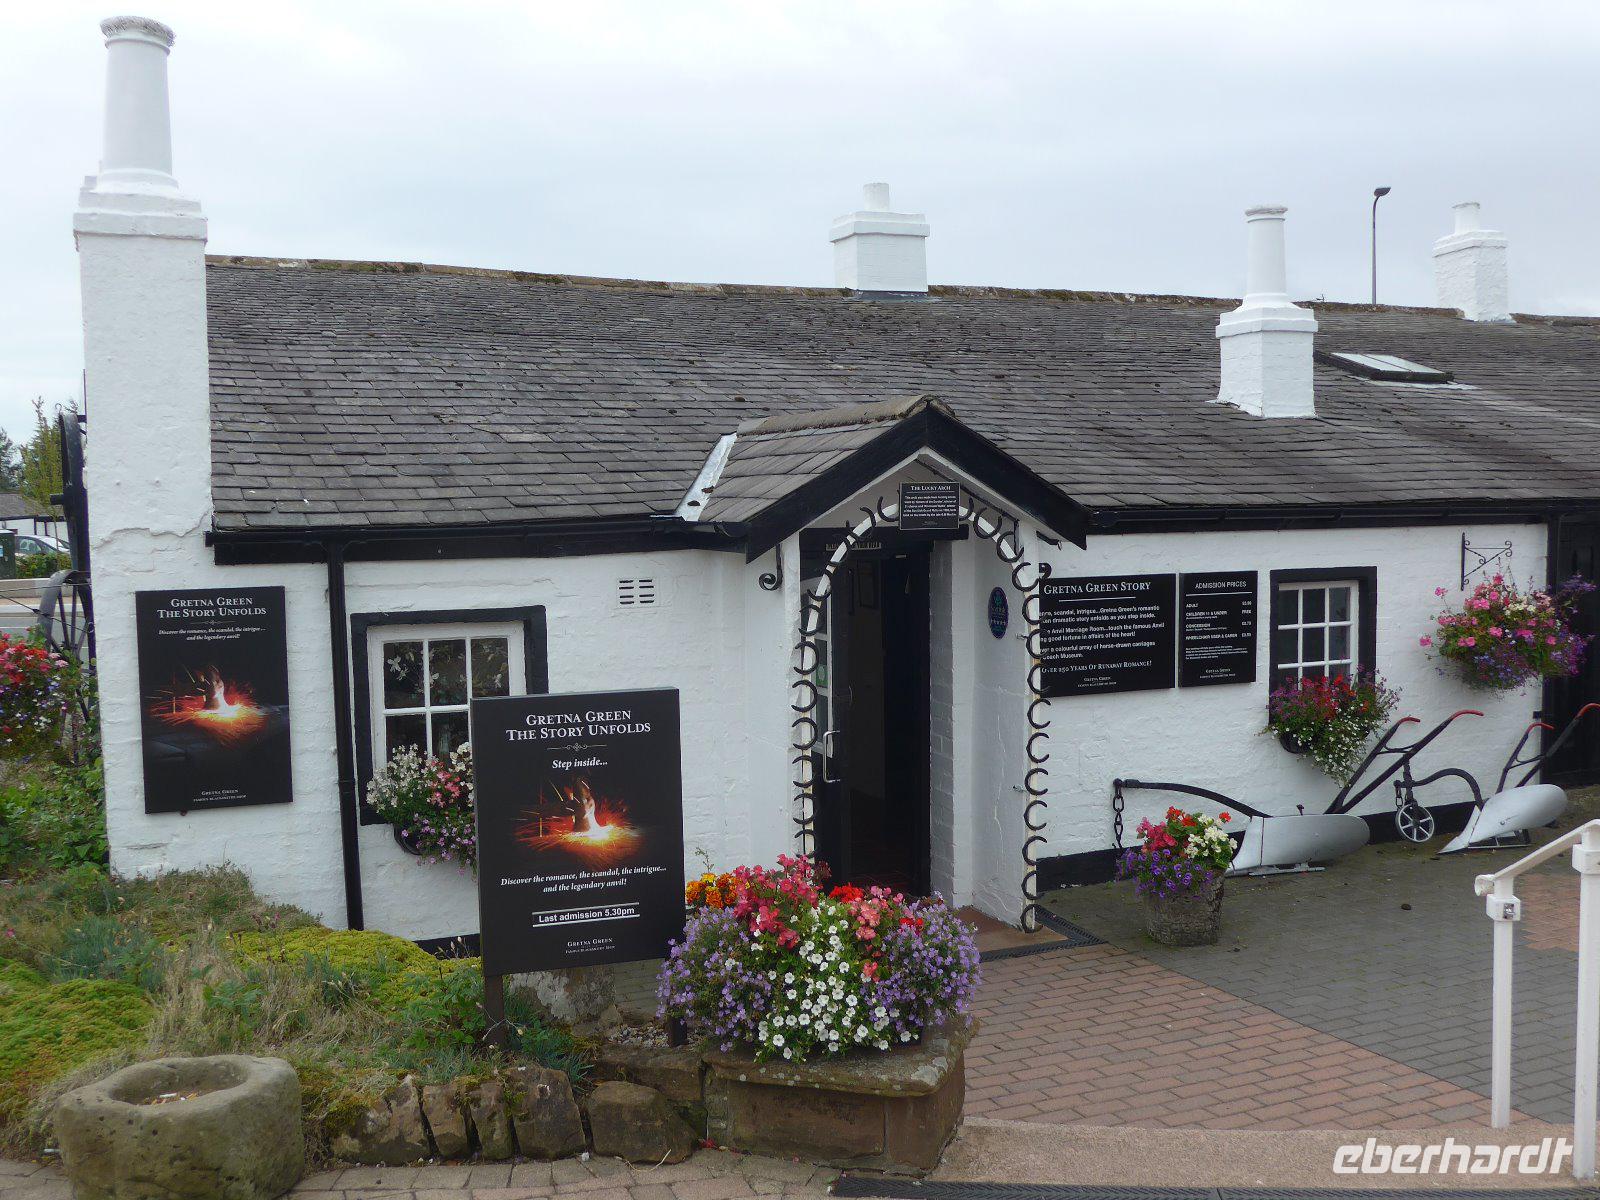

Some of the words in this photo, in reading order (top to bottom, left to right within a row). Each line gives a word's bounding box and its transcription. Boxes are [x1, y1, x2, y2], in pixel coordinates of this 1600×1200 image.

[1043, 585, 1083, 594] GRETNA
[1085, 583, 1118, 592] GREEN
[1121, 581, 1151, 591] STORY
[171, 599, 214, 608] GRETNA
[217, 597, 253, 606] GREEN
[157, 609, 181, 619] THE
[183, 608, 216, 618] STORY
[219, 607, 267, 616] UNFOLDS
[1065, 626, 1088, 634] Marriage
[1048, 635, 1061, 643] good
[1099, 641, 1132, 649] horse-drawn
[1070, 664, 1088, 672] YEARS
[1098, 662, 1122, 670] RUNAWAY
[1124, 660, 1152, 668] ROMANCE!
[526, 714, 582, 726] GRETNA
[585, 710, 631, 722] GREEN
[506, 729, 537, 741] THE
[540, 726, 584, 739] STORY
[588, 723, 651, 736] UNFOLDS
[552, 759, 572, 770] Step
[574, 757, 608, 767] inside...
[500, 877, 532, 886] Discover
[533, 875, 544, 883] the
[545, 873, 578, 882] romance,
[579, 871, 590, 879] the
[591, 868, 620, 877] scandal,
[622, 867, 633, 875] the
[633, 865, 667, 875] intrigue...
[543, 884, 557, 893] and
[558, 882, 570, 891] the
[571, 880, 605, 892] legendary
[606, 878, 627, 887] anvil!
[538, 914, 558, 923] Last
[559, 911, 603, 921] admission
[604, 907, 635, 917] 5.30pm
